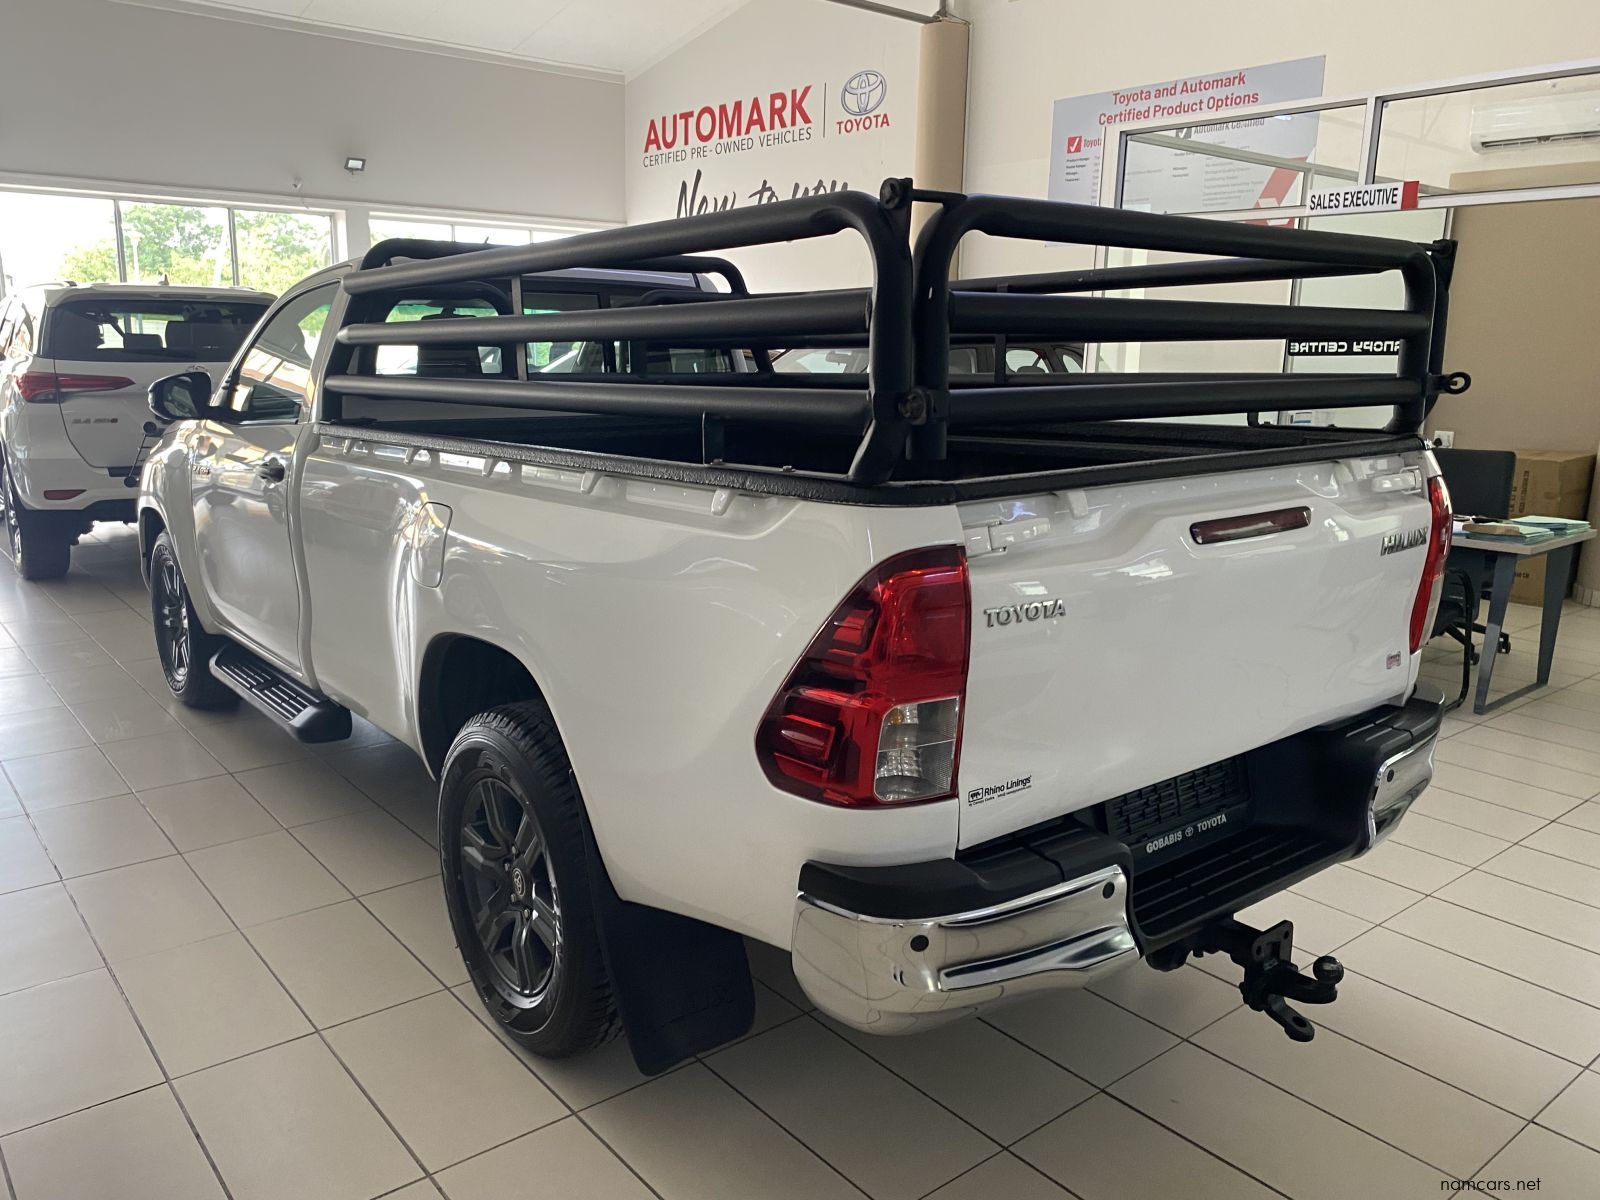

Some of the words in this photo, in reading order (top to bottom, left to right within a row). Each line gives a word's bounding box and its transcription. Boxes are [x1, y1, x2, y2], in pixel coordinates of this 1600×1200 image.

[1112, 89, 1151, 106] Toyota
[1154, 83, 1177, 98] and
[1180, 72, 1246, 95] Automark
[643, 85, 812, 153] AUTOMARK
[836, 113, 890, 135] TOYOTA
[1098, 105, 1150, 126] Certified
[1153, 98, 1204, 119] Product
[1207, 91, 1259, 110] Options
[643, 149, 687, 168] CERTIFIED
[758, 127, 812, 148] VEHICLES
[677, 168, 736, 218] New
[1309, 191, 1341, 211] SALES
[1342, 187, 1399, 208] EXECUTIVE
[1380, 526, 1428, 557] HILUX
[983, 599, 1066, 628] TOYOTA
[984, 785, 1005, 797] Rhino
[1146, 831, 1182, 854] GOBABIS
[1197, 813, 1227, 833] TOYOTA
